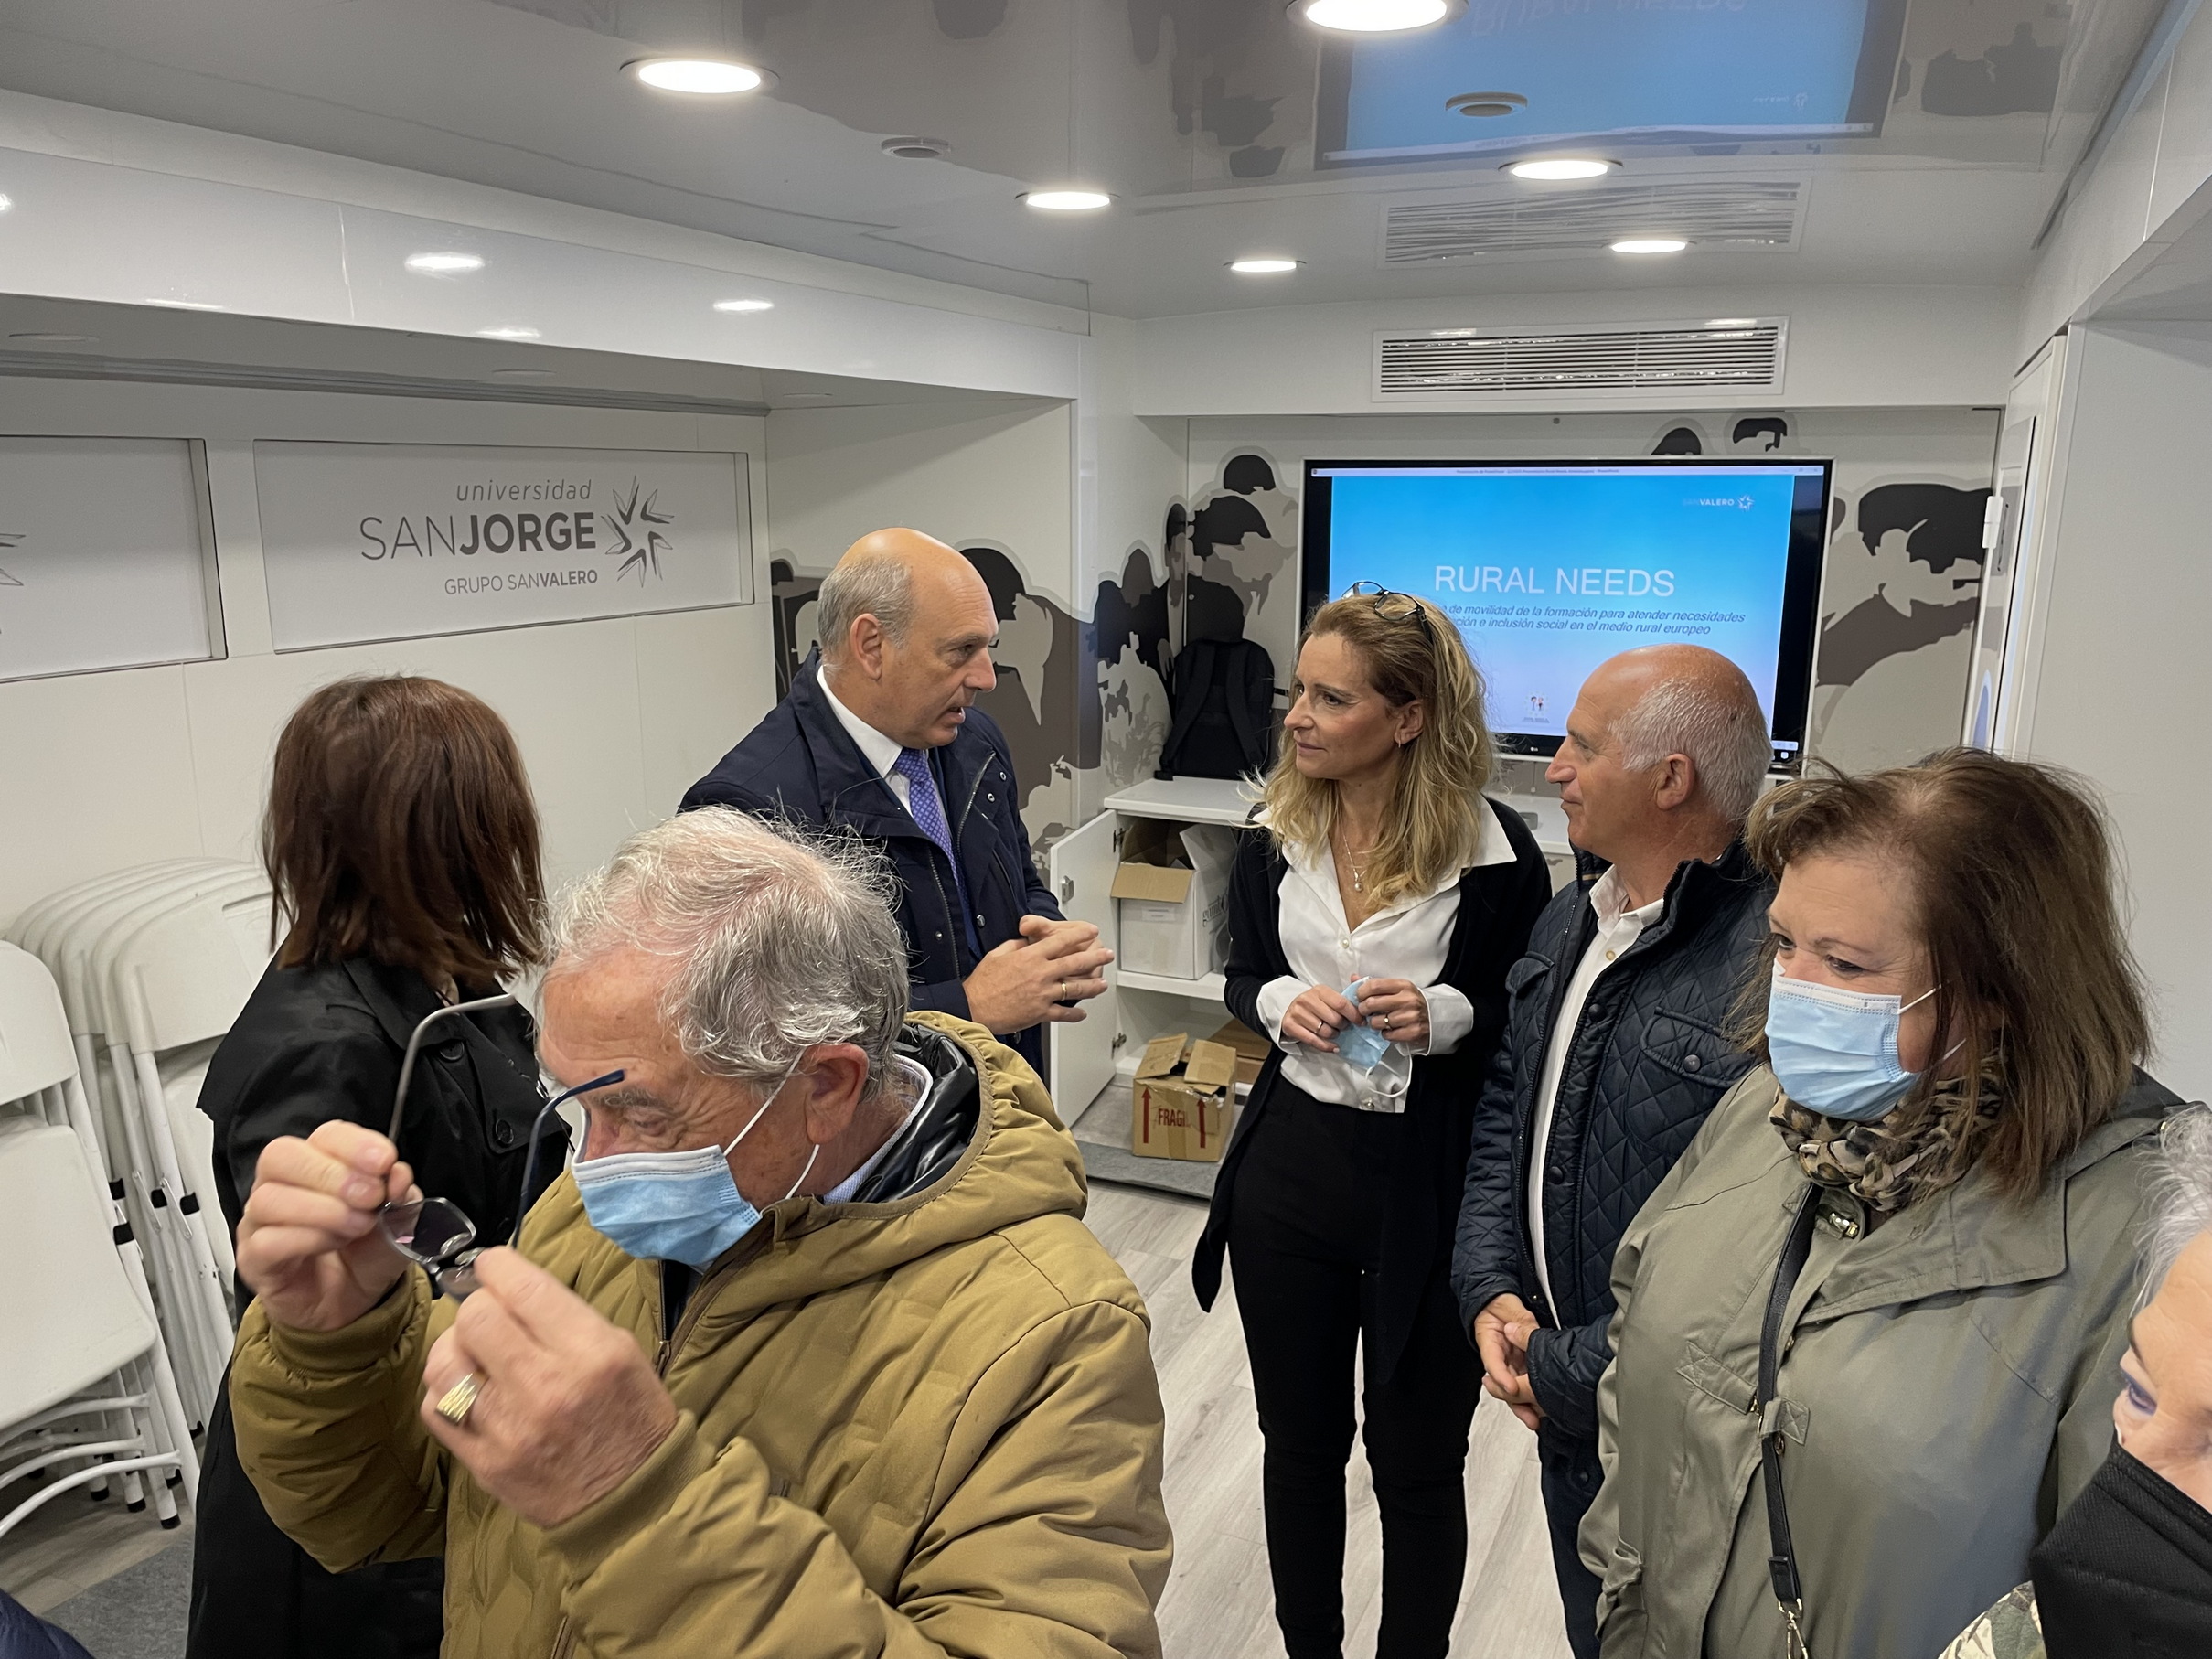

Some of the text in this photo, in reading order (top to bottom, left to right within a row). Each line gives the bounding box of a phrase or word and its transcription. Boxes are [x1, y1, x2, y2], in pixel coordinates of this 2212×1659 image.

[457, 479, 592, 501] universidad
[360, 512, 596, 561] SANJORGE
[444, 569, 598, 594] GRUPO SANVALERO
[1435, 565, 1675, 597] RURAL NEEDS
[1449, 605, 1462, 614] de
[1464, 605, 1515, 615] movilidad
[1516, 605, 1530, 615] de
[1532, 606, 1542, 616] la
[1544, 606, 1598, 617] formación
[1598, 610, 1625, 620] para
[1627, 610, 1672, 620] atender
[1672, 611, 1746, 623] necesidades
[1479, 619, 1487, 627] e
[1488, 617, 1534, 628] inclusión
[1536, 619, 1568, 630] social
[1569, 622, 1584, 630] en
[1586, 621, 1598, 631] el
[1598, 622, 1633, 632] medio
[1635, 623, 1662, 633] rural
[1663, 626, 1711, 636] europeo
[1158, 1108, 1191, 1128] FRAGI
